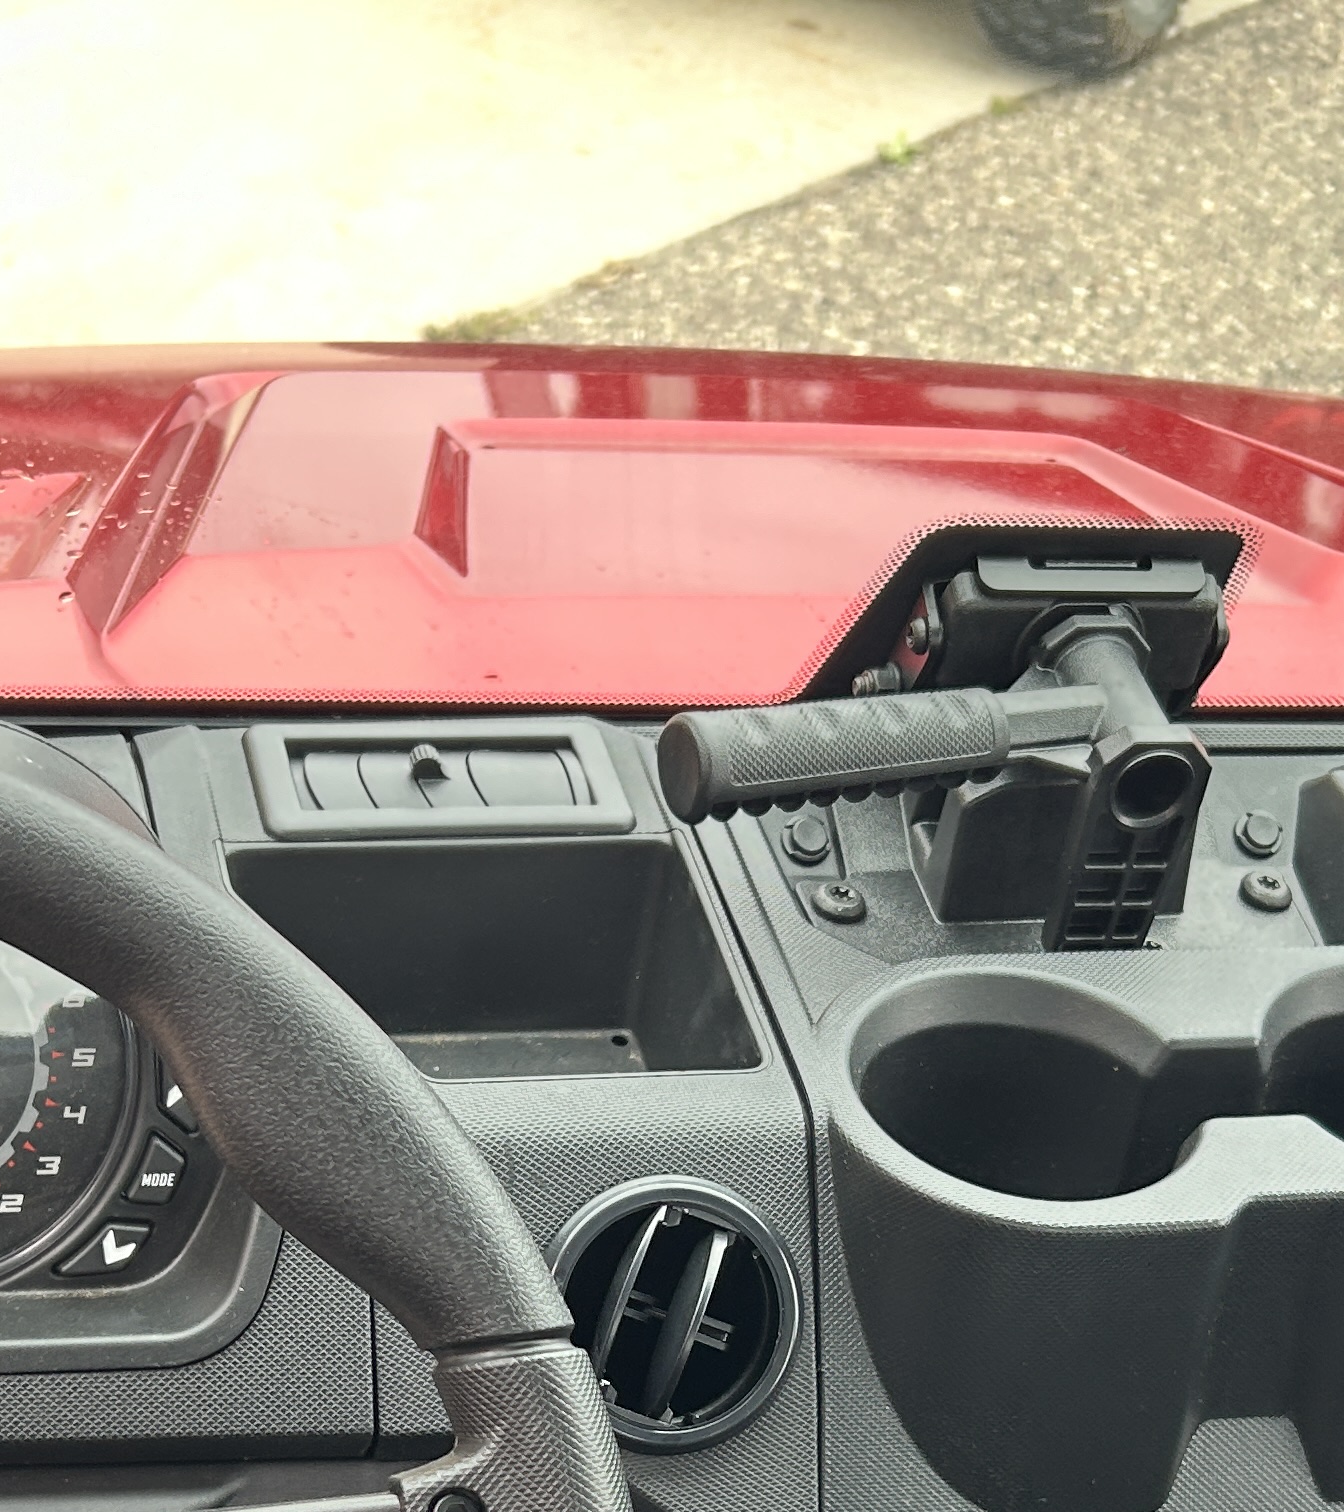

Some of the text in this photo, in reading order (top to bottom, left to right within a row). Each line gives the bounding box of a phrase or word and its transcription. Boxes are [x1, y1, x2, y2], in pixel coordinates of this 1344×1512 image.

[71, 1047, 97, 1068] 5
[63, 1105, 88, 1125] 4
[36, 1156, 61, 1176] 3
[140, 1171, 177, 1189] MODE
